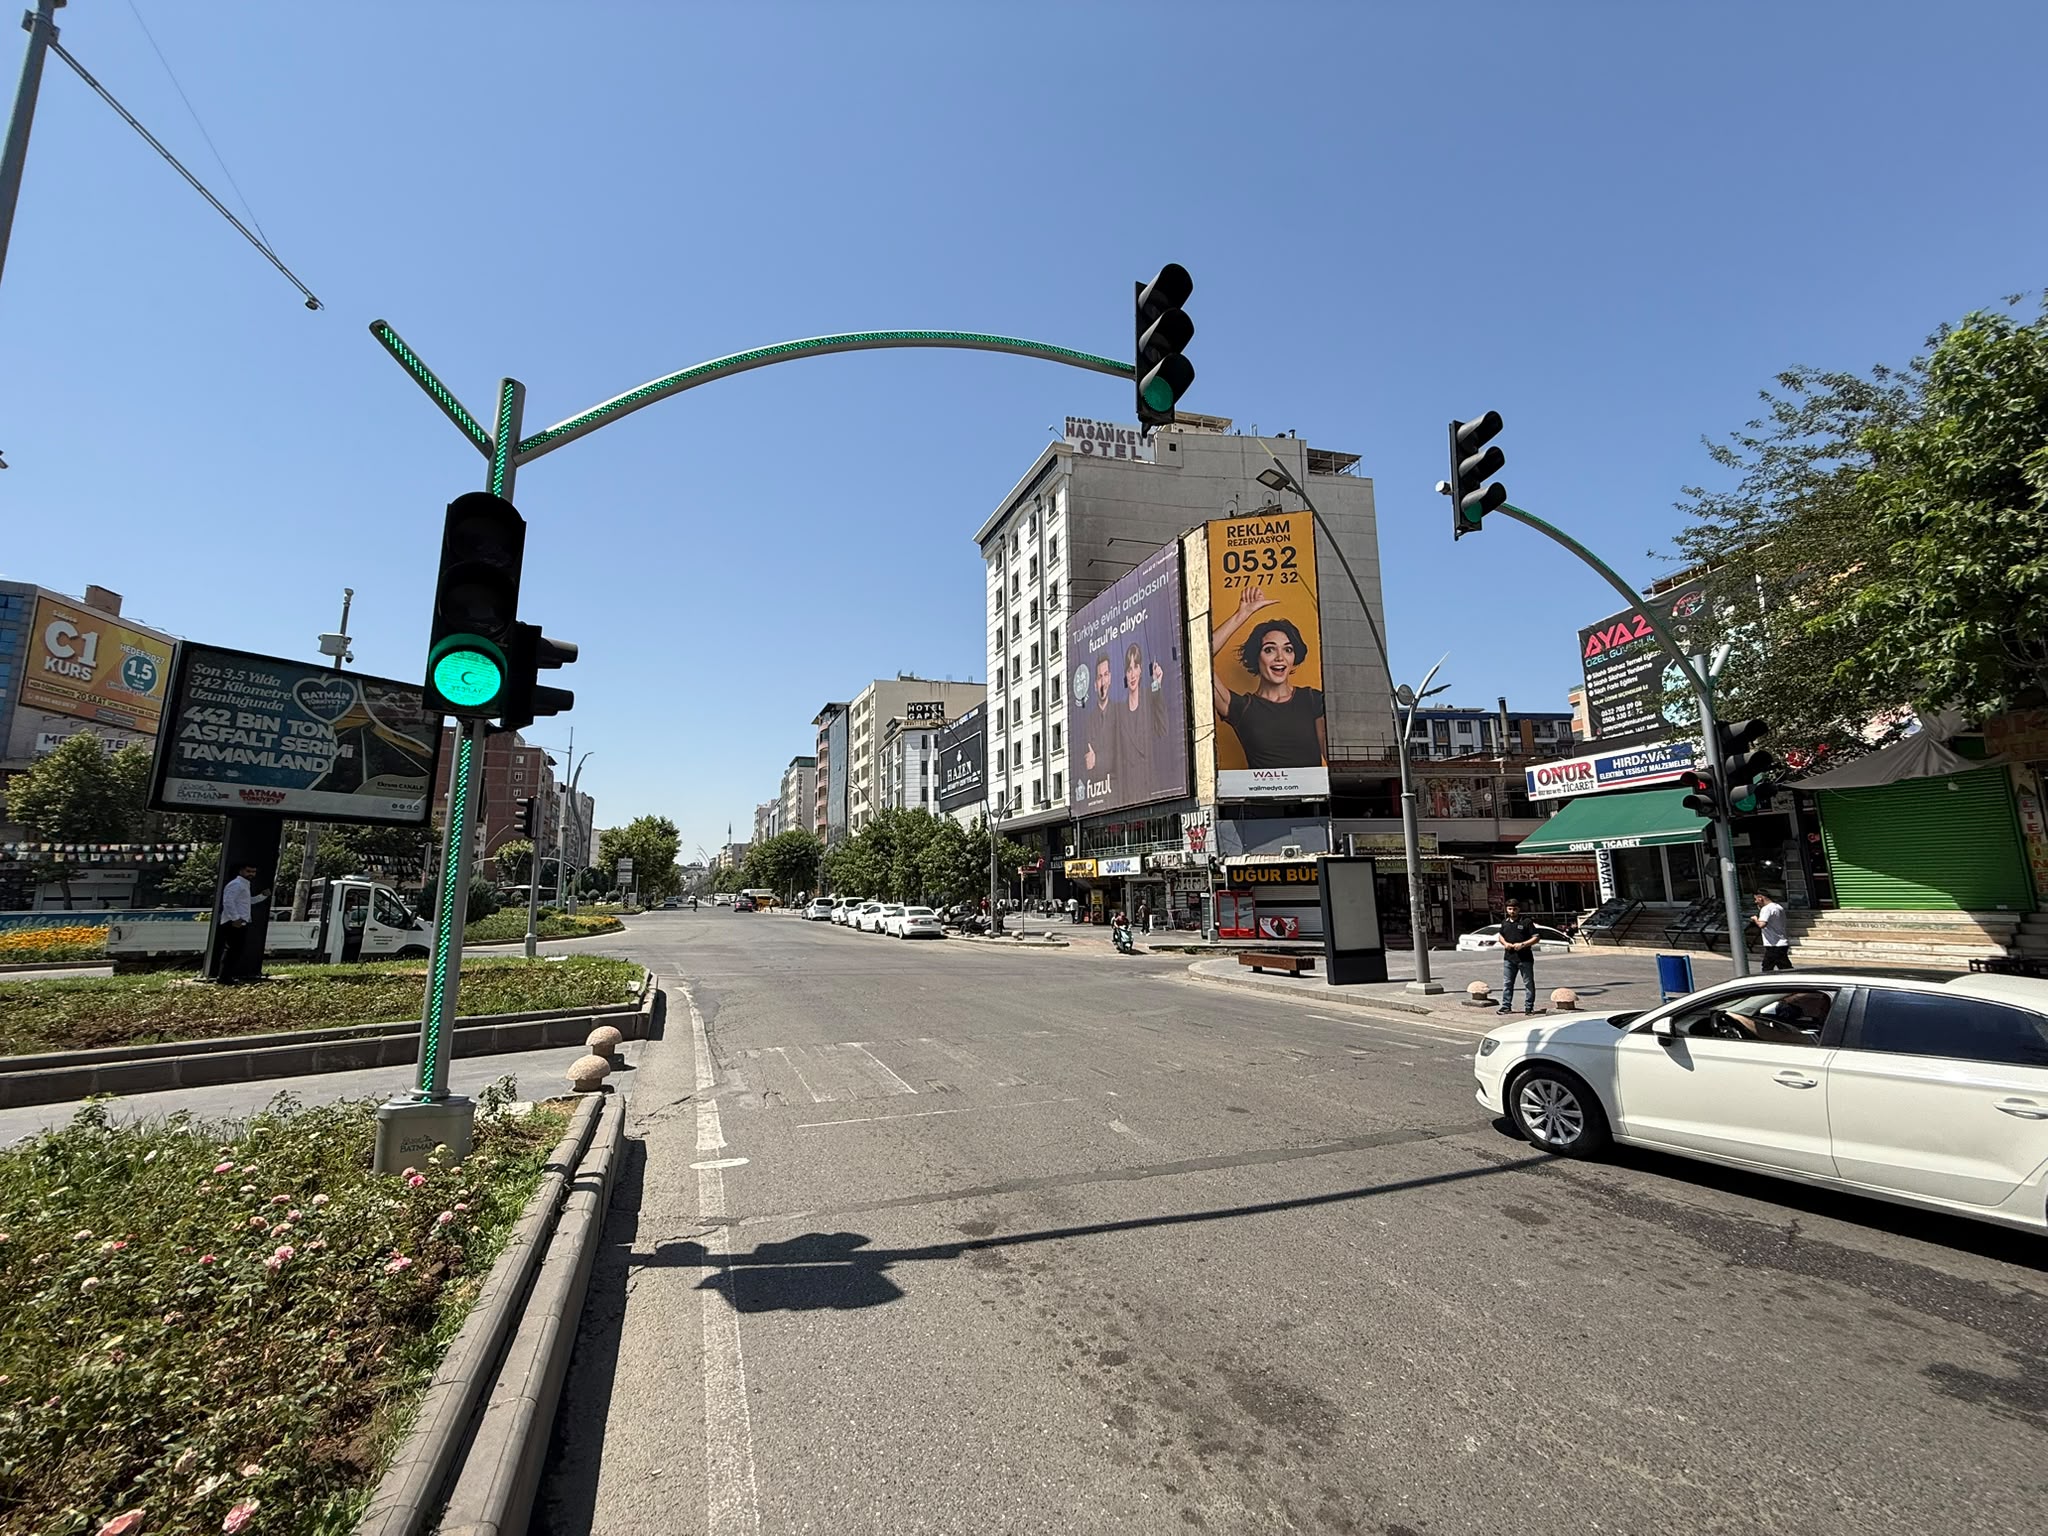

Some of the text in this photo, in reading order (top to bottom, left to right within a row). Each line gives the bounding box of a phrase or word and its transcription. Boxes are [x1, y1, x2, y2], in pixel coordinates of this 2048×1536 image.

[1066, 416, 1092, 425] GRAND
[1080, 440, 1142, 459] OTEL
[1227, 520, 1290, 538] REKLAM
[1227, 534, 1291, 547] REZERVASYON
[1223, 546, 1297, 574] 0532
[1224, 571, 1298, 588] 277 77 32
[1072, 572, 1169, 645] Türkiye evini arabasını
[44, 620, 99, 668] C1
[44, 656, 93, 682] KURS
[127, 659, 153, 681] 1,5
[191, 662, 281, 687] Son 3,5 Yılda
[189, 675, 292, 701] 342 Kilometre
[301, 691, 350, 700] BATMAN
[188, 687, 285, 712] Uzunluğunda
[908, 703, 945, 712] HOTEL
[183, 706, 231, 726] 442
[287, 719, 335, 741] TON
[180, 723, 278, 748] ASFALT
[179, 741, 334, 774] TAMAMLANDI
[1612, 749, 1672, 769] HIRDAVAT
[1253, 770, 1288, 778] WALL
[1537, 761, 1594, 786] ONUR
[1625, 764, 1649, 777] TESİSAT
[177, 789, 220, 800] BATMAN
[239, 788, 287, 800] BATMAN
[1087, 773, 1112, 799] fuzul
[1248, 784, 1299, 792] wallmedya.com
[1562, 780, 1595, 794] TİCARET
[1569, 842, 1595, 852] ONUR
[1232, 866, 1282, 882] UĞUR
[400, 1142, 435, 1153] BATMAN
